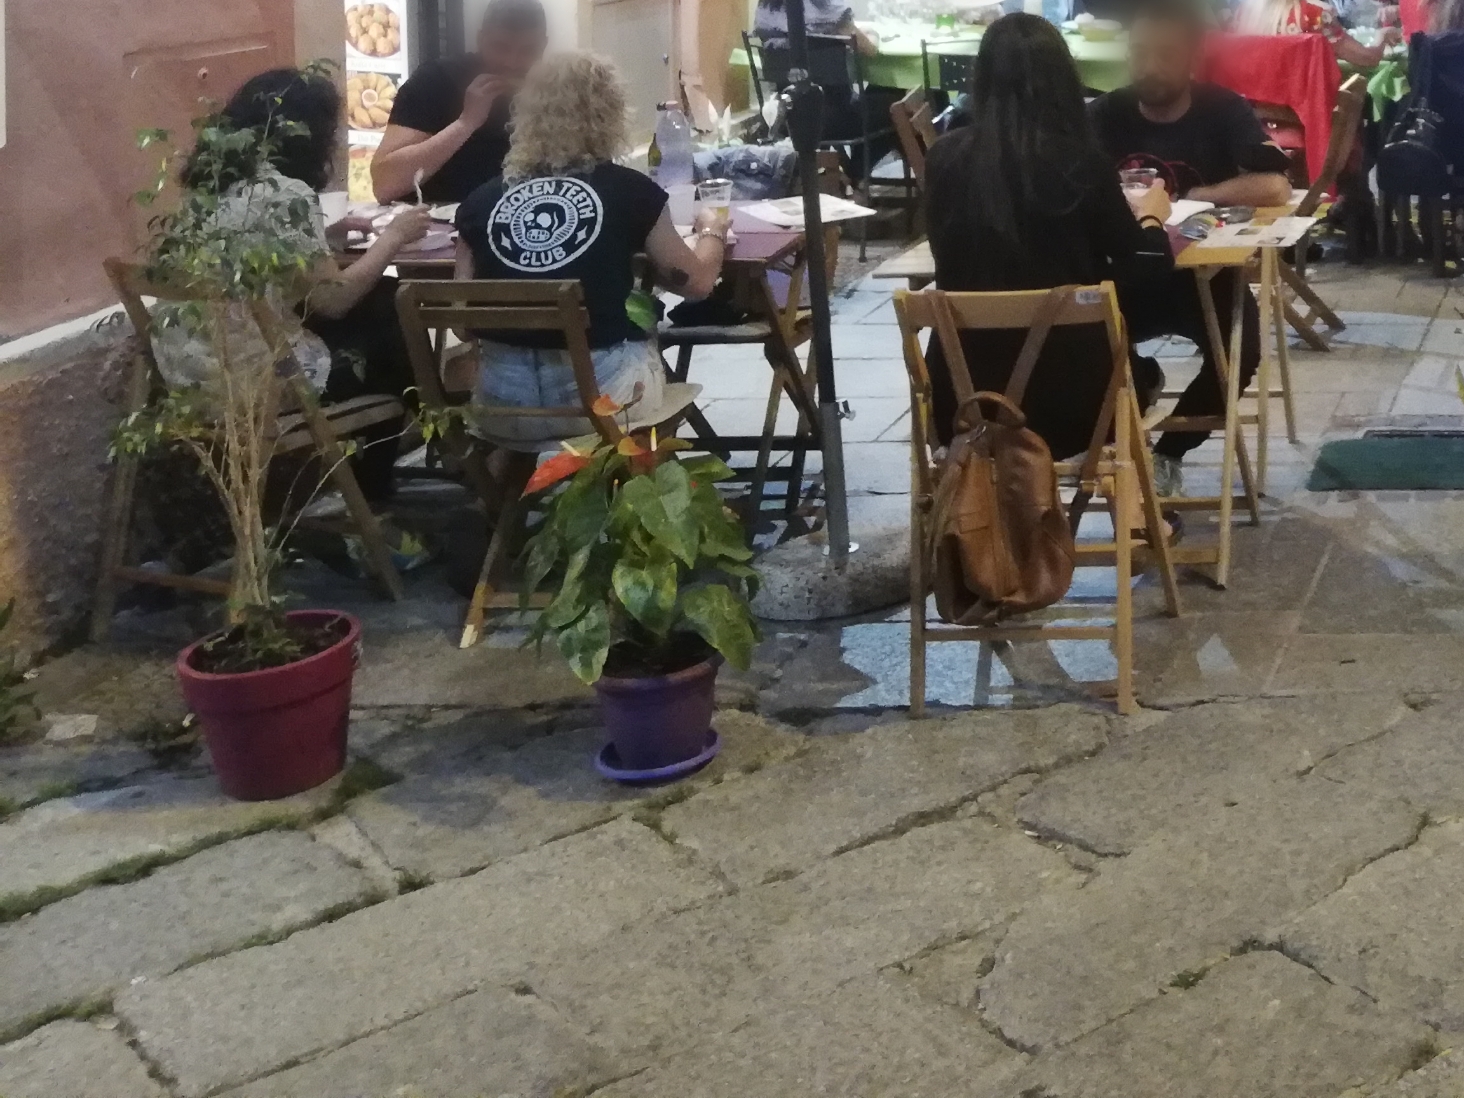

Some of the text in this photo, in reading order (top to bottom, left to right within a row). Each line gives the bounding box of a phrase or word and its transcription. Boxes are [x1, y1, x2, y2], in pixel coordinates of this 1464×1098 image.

[495, 180, 596, 224] BROKEN TEETH
[519, 247, 567, 266] CLUB
